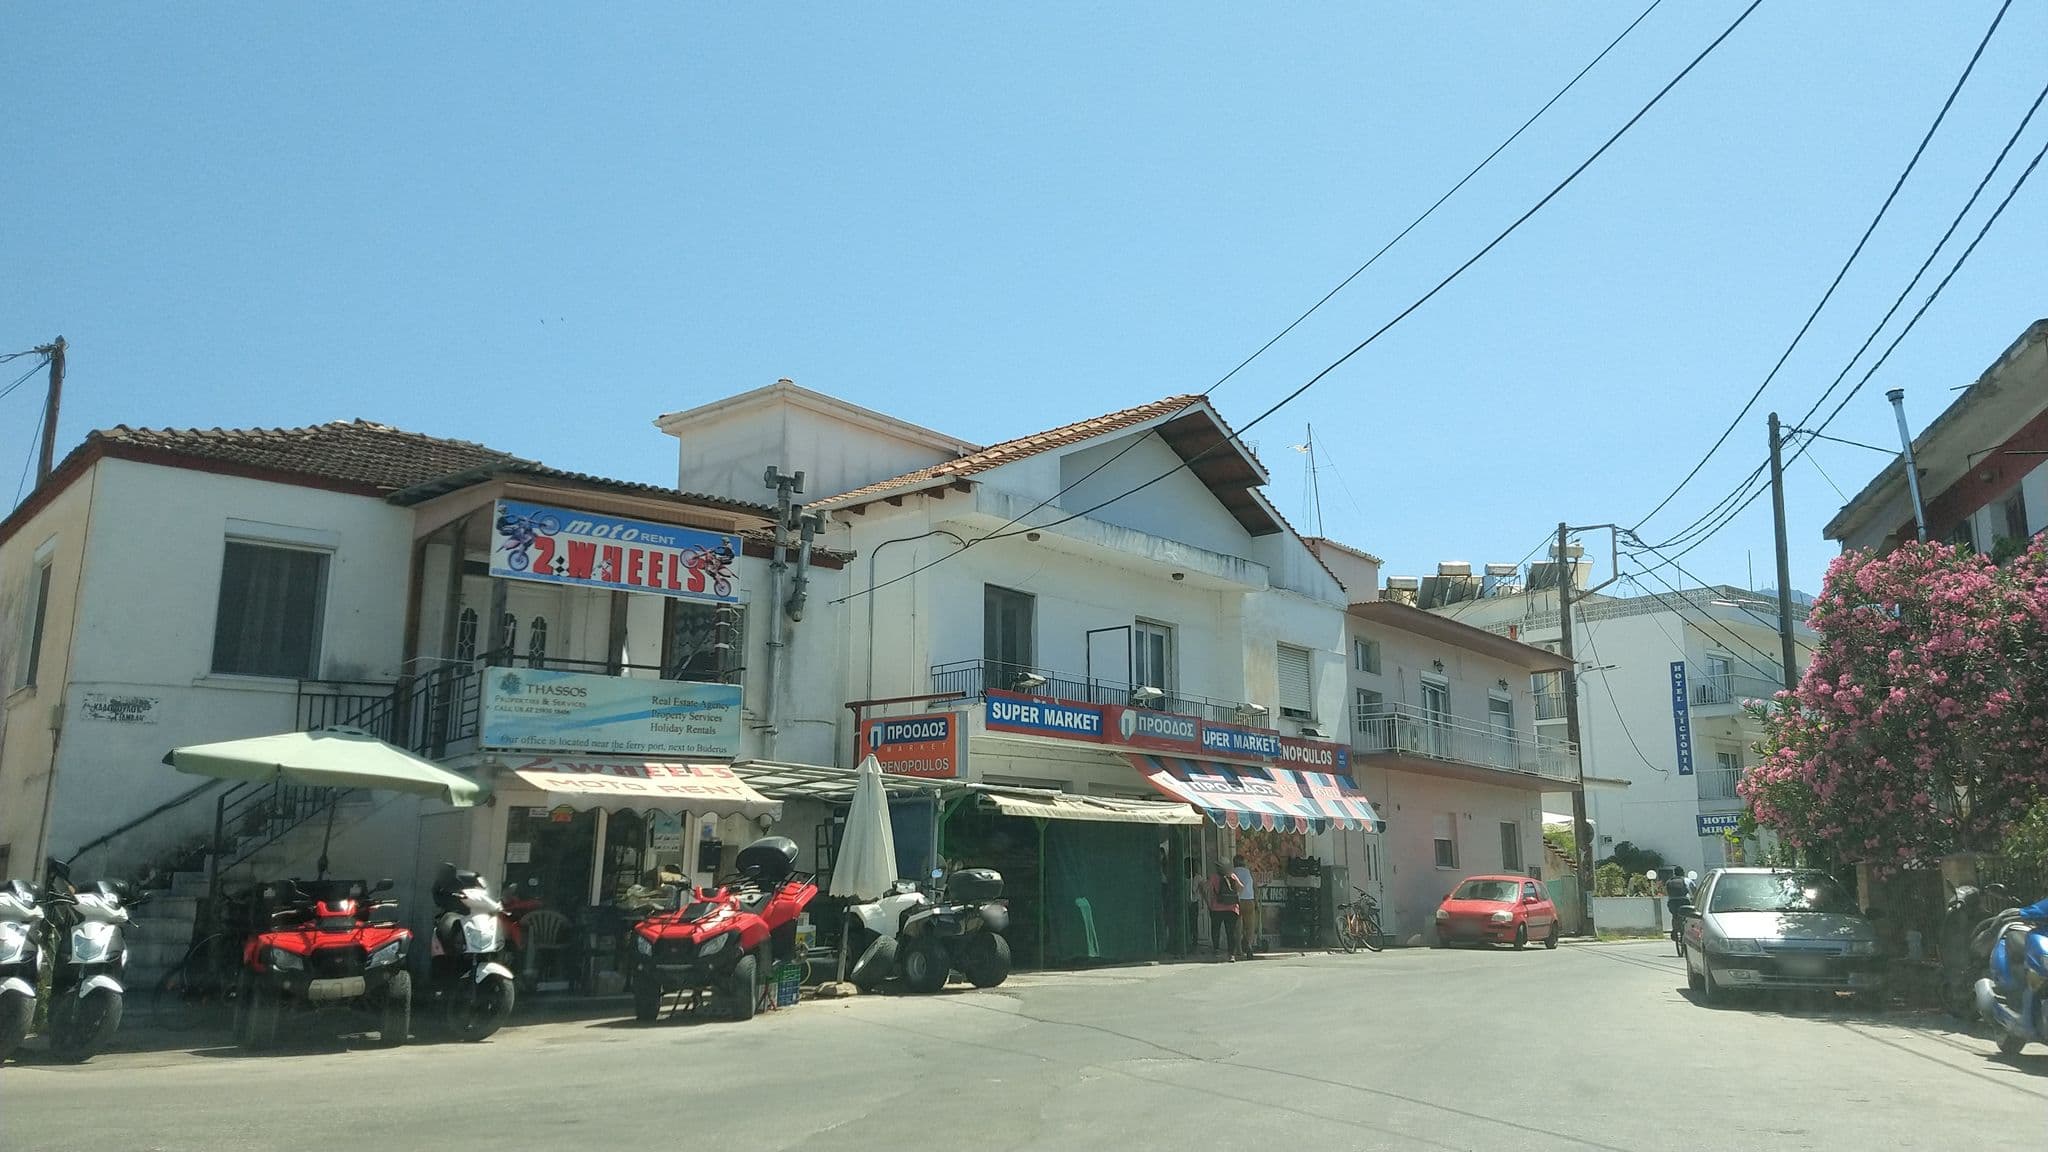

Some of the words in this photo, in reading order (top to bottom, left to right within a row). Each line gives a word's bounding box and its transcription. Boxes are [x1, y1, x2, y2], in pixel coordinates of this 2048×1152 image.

[564, 519, 639, 541] moto
[641, 533, 675, 545] RENT
[567, 540, 706, 593] WHEELS
[526, 684, 587, 698] THASSOS
[1674, 665, 1684, 702] HOTEL
[543, 697, 549, 705] &
[652, 696, 671, 706] Real
[673, 697, 698, 708] Estate
[701, 701, 730, 712] Agency
[651, 709, 686, 721] Property
[689, 712, 722, 722] Services
[992, 701, 1039, 724] SUPER
[1044, 708, 1100, 732] MARKET
[650, 722, 683, 735] Holiday
[686, 725, 716, 735] Rentals
[887, 721, 946, 740] ΠΡΟΟΔΟΣ
[1138, 716, 1194, 737] ΠΡΟΟΔΟΣ
[501, 735, 519, 745] Our
[521, 736, 546, 745] office
[549, 737, 556, 746] is
[559, 737, 589, 747] located
[591, 740, 609, 748] near
[611, 740, 624, 749] the
[626, 741, 645, 751] ferry
[647, 742, 665, 752] port,
[668, 743, 685, 752] next
[687, 743, 695, 752] to
[697, 744, 727, 753] Buderus
[886, 742, 946, 752] MARKET
[1233, 735, 1276, 753] MARKET
[1676, 710, 1690, 771] VICTORIA
[516, 757, 558, 772] 2
[555, 762, 736, 779] WHEELS
[546, 778, 647, 791] MOTO
[657, 784, 743, 795] RENT
